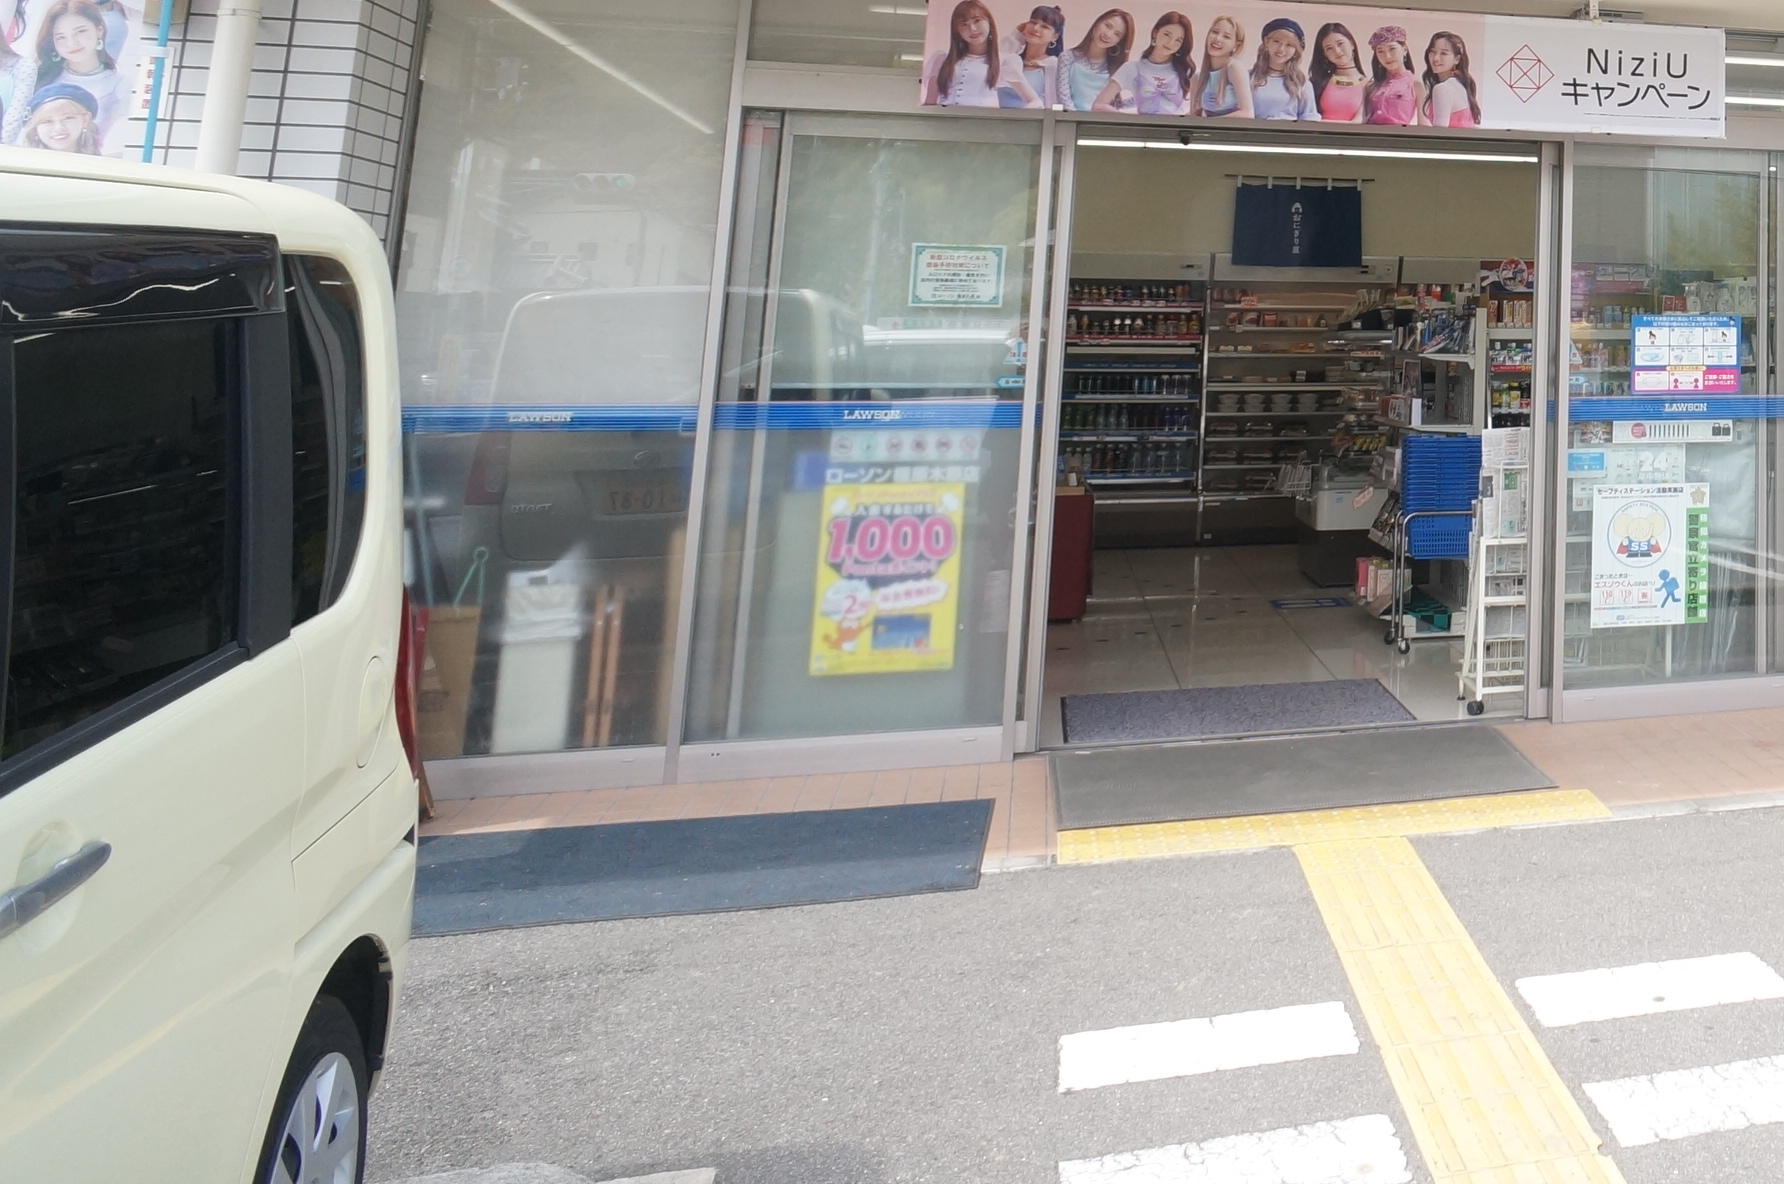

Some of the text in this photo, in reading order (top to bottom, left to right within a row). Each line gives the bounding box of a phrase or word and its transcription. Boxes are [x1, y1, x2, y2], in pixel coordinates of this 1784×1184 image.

[1586, 47, 1688, 79] NiziU
[1560, 77, 1711, 110] キャンペーン
[1663, 402, 1708, 412] LAWSON
[507, 412, 573, 423] LAWSON
[843, 409, 901, 420] LAWSON
[1630, 541, 1649, 551] SS
